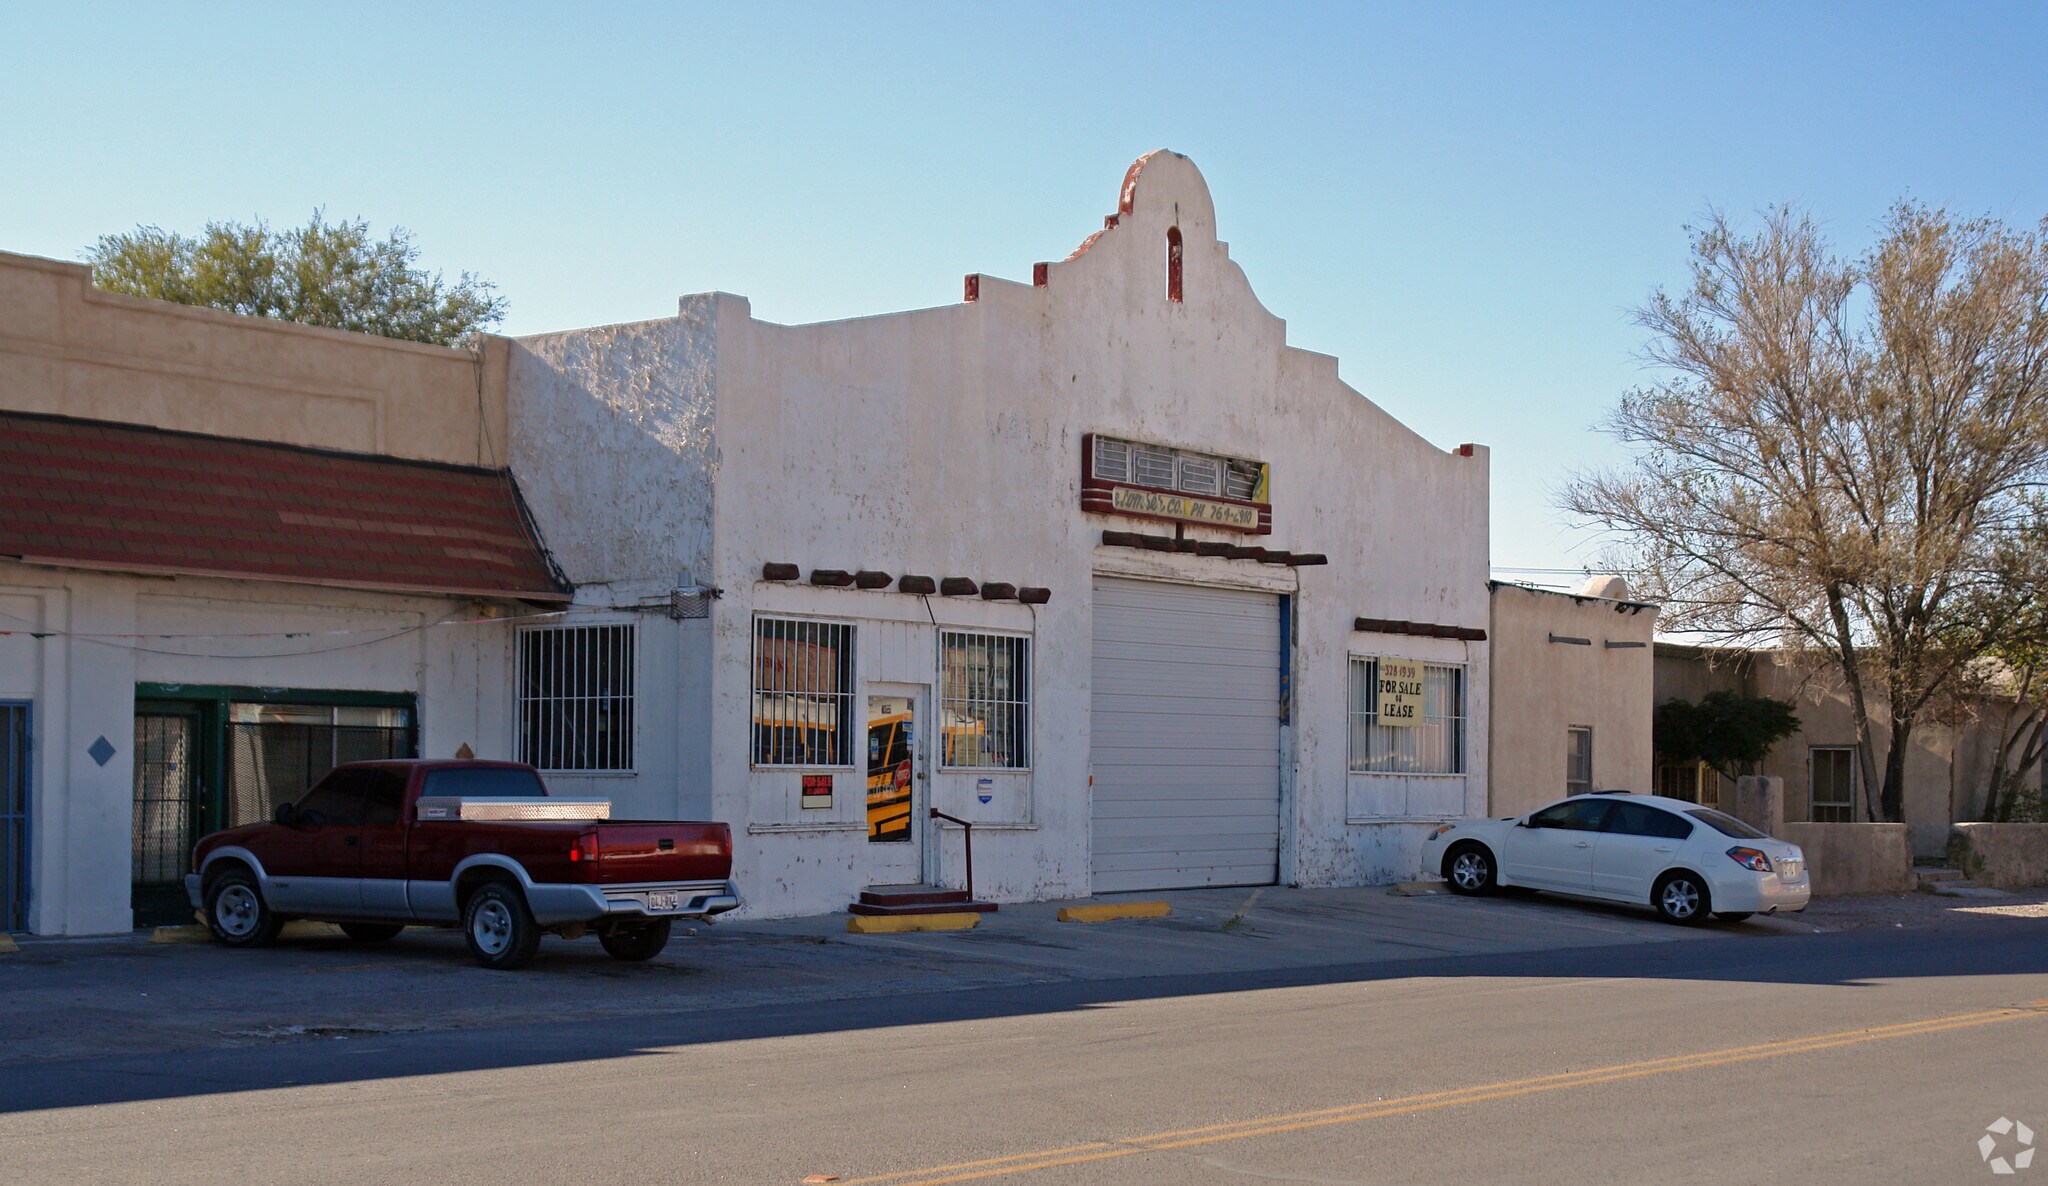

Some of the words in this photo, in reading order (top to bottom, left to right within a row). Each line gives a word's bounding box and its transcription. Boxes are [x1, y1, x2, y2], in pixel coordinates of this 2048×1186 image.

[1379, 680, 1397, 693] FOR
[1398, 681, 1422, 695] SALE
[1395, 694, 1403, 702] OR
[1384, 703, 1414, 718] LEASE
[803, 776, 816, 787] FOR
[816, 776, 832, 787] SALE
